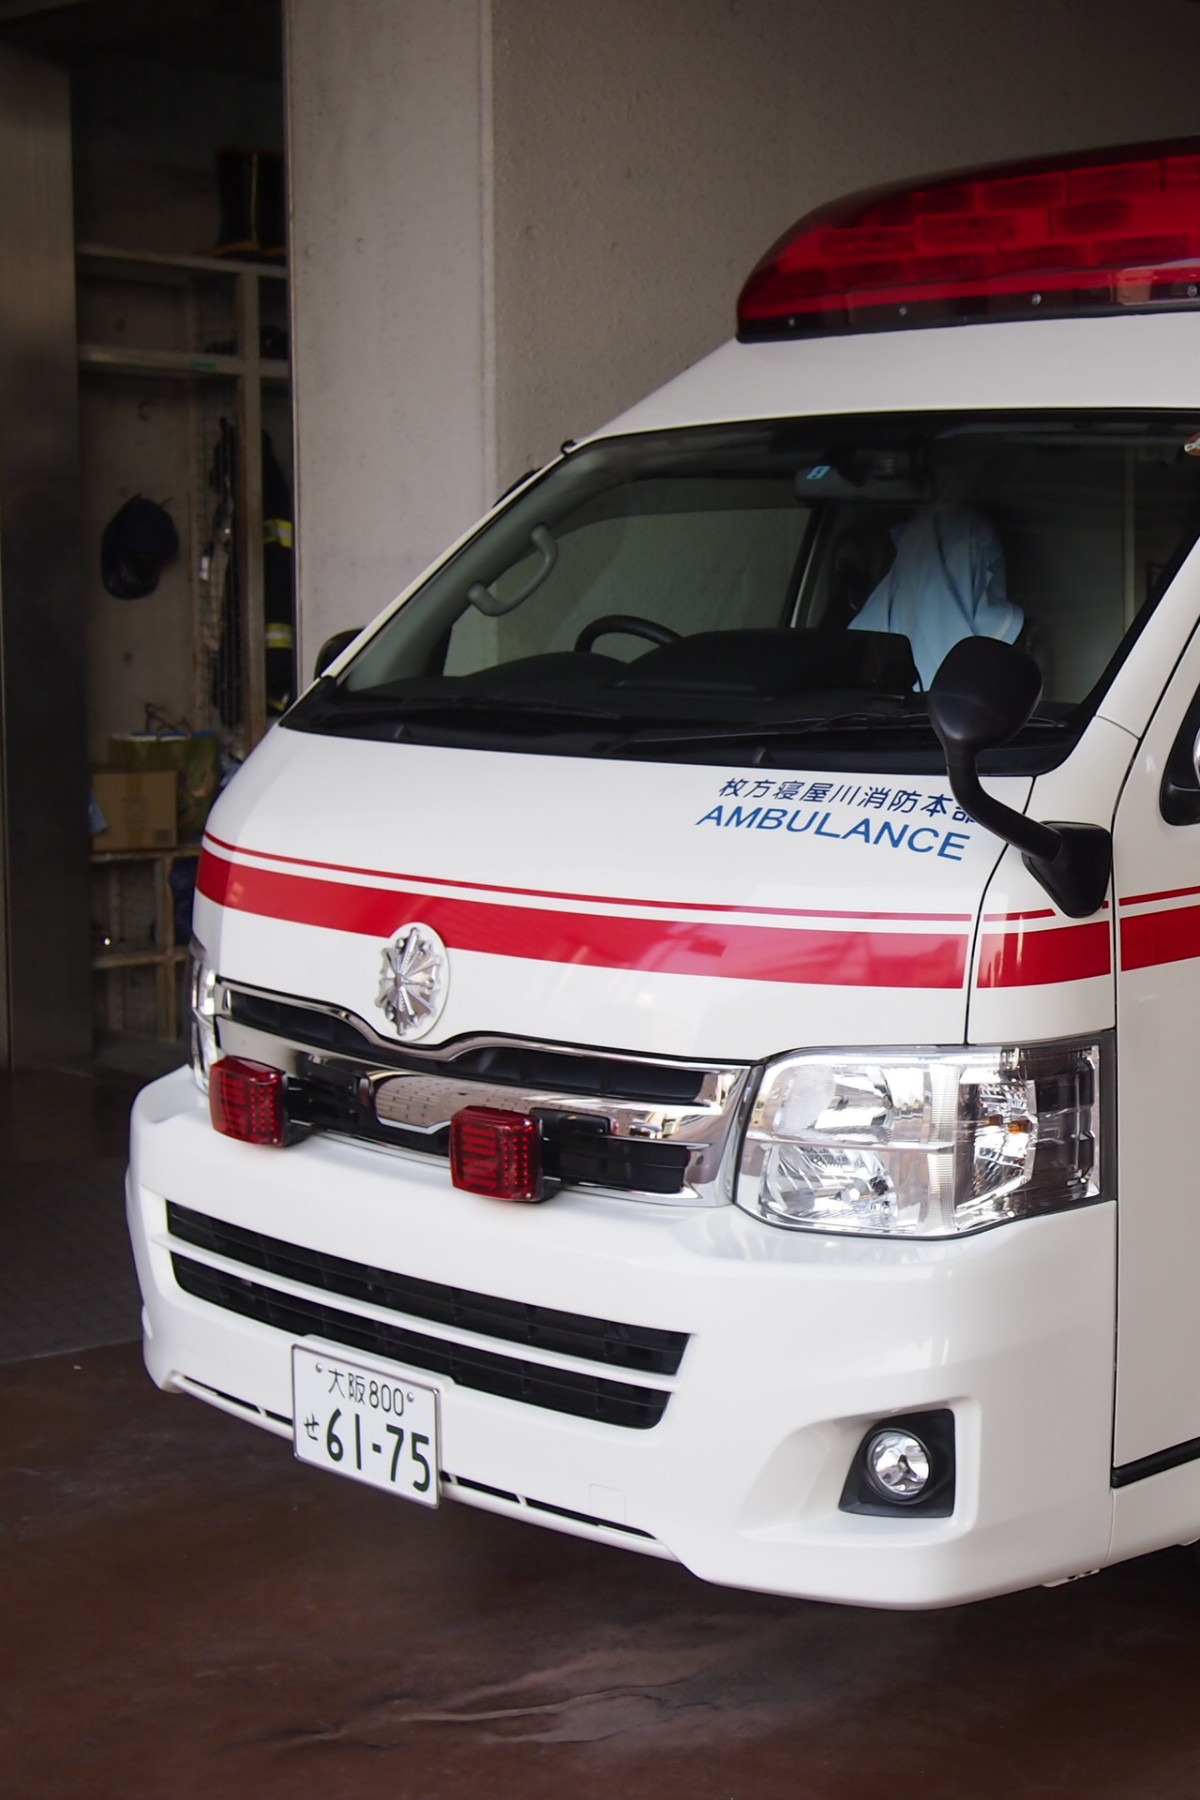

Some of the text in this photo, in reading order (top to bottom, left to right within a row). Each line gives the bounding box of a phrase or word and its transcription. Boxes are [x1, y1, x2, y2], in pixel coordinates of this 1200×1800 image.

[695, 805, 970, 861] AMBULANCE
[328, 1368, 404, 1417] 大阪800
[303, 1408, 430, 1493] せ 61-75
